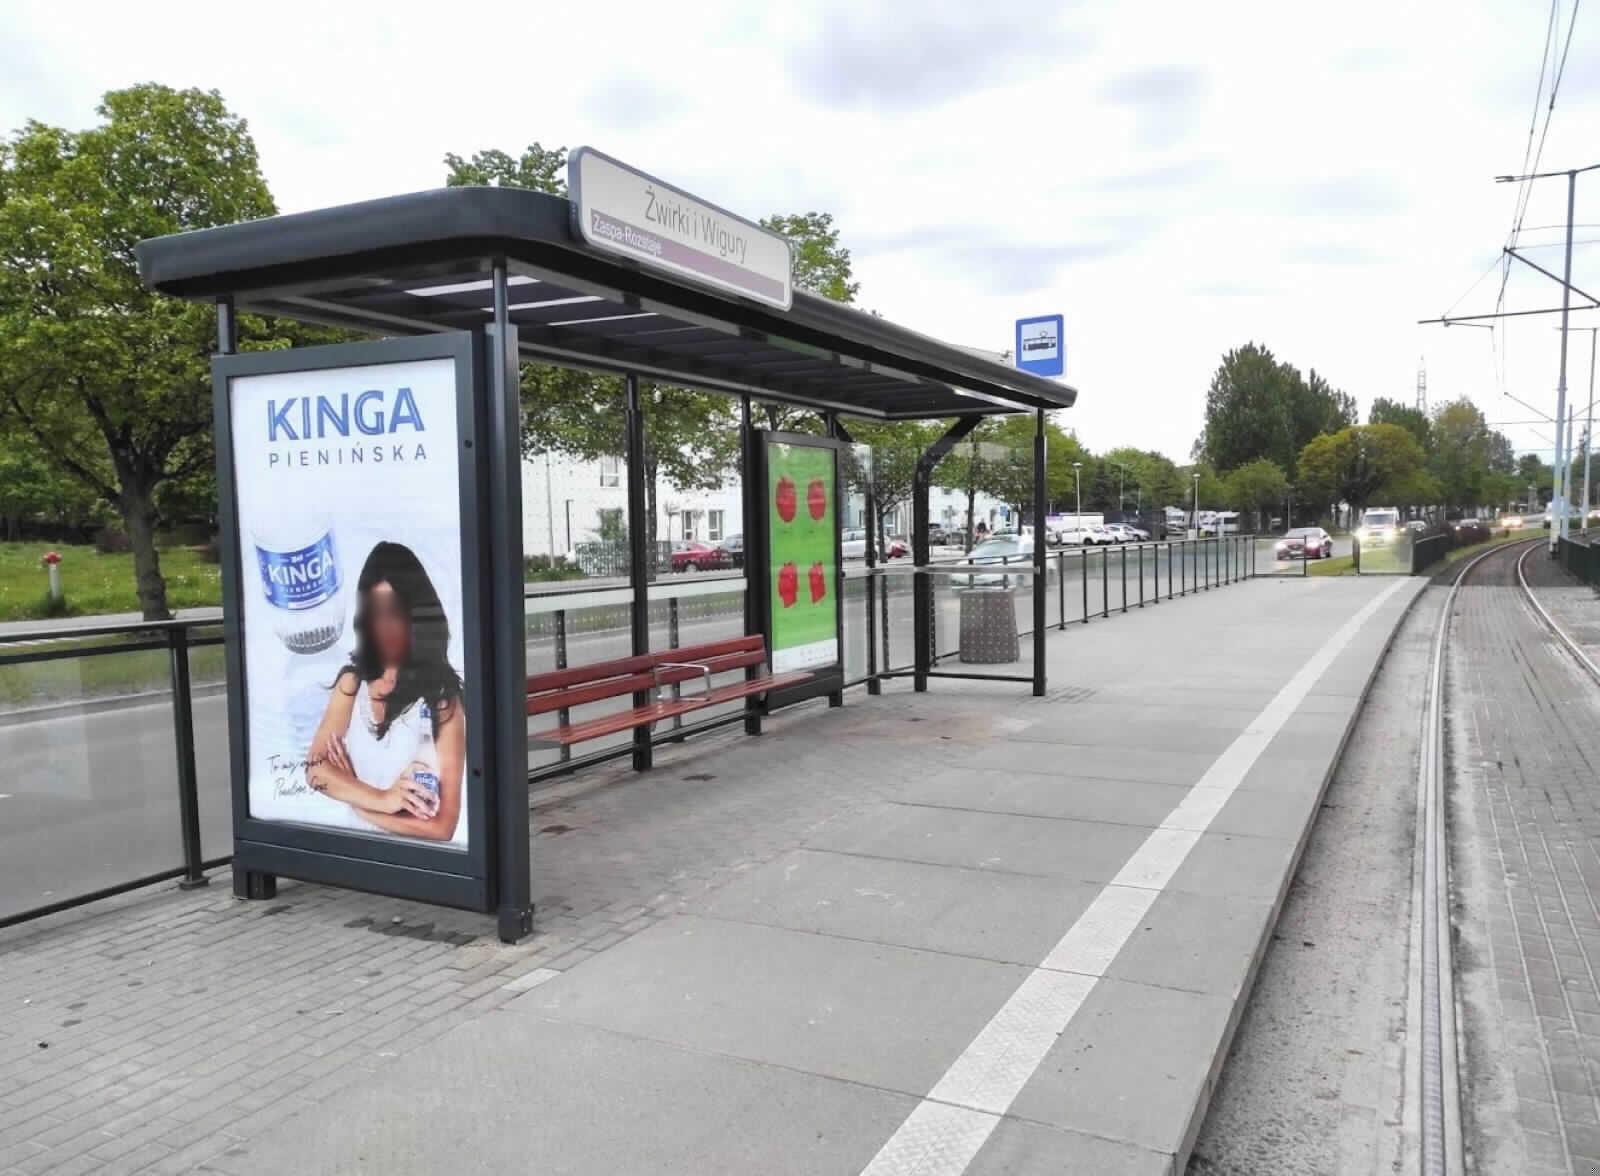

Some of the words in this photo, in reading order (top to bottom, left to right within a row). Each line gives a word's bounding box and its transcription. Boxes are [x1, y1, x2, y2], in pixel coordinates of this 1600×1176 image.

[645, 184, 690, 236] Żwirki
[701, 215, 748, 264] Wigury
[267, 387, 425, 442] KINGA
[269, 441, 427, 468] PIENIŃSKA
[268, 549, 334, 585] KINGA
